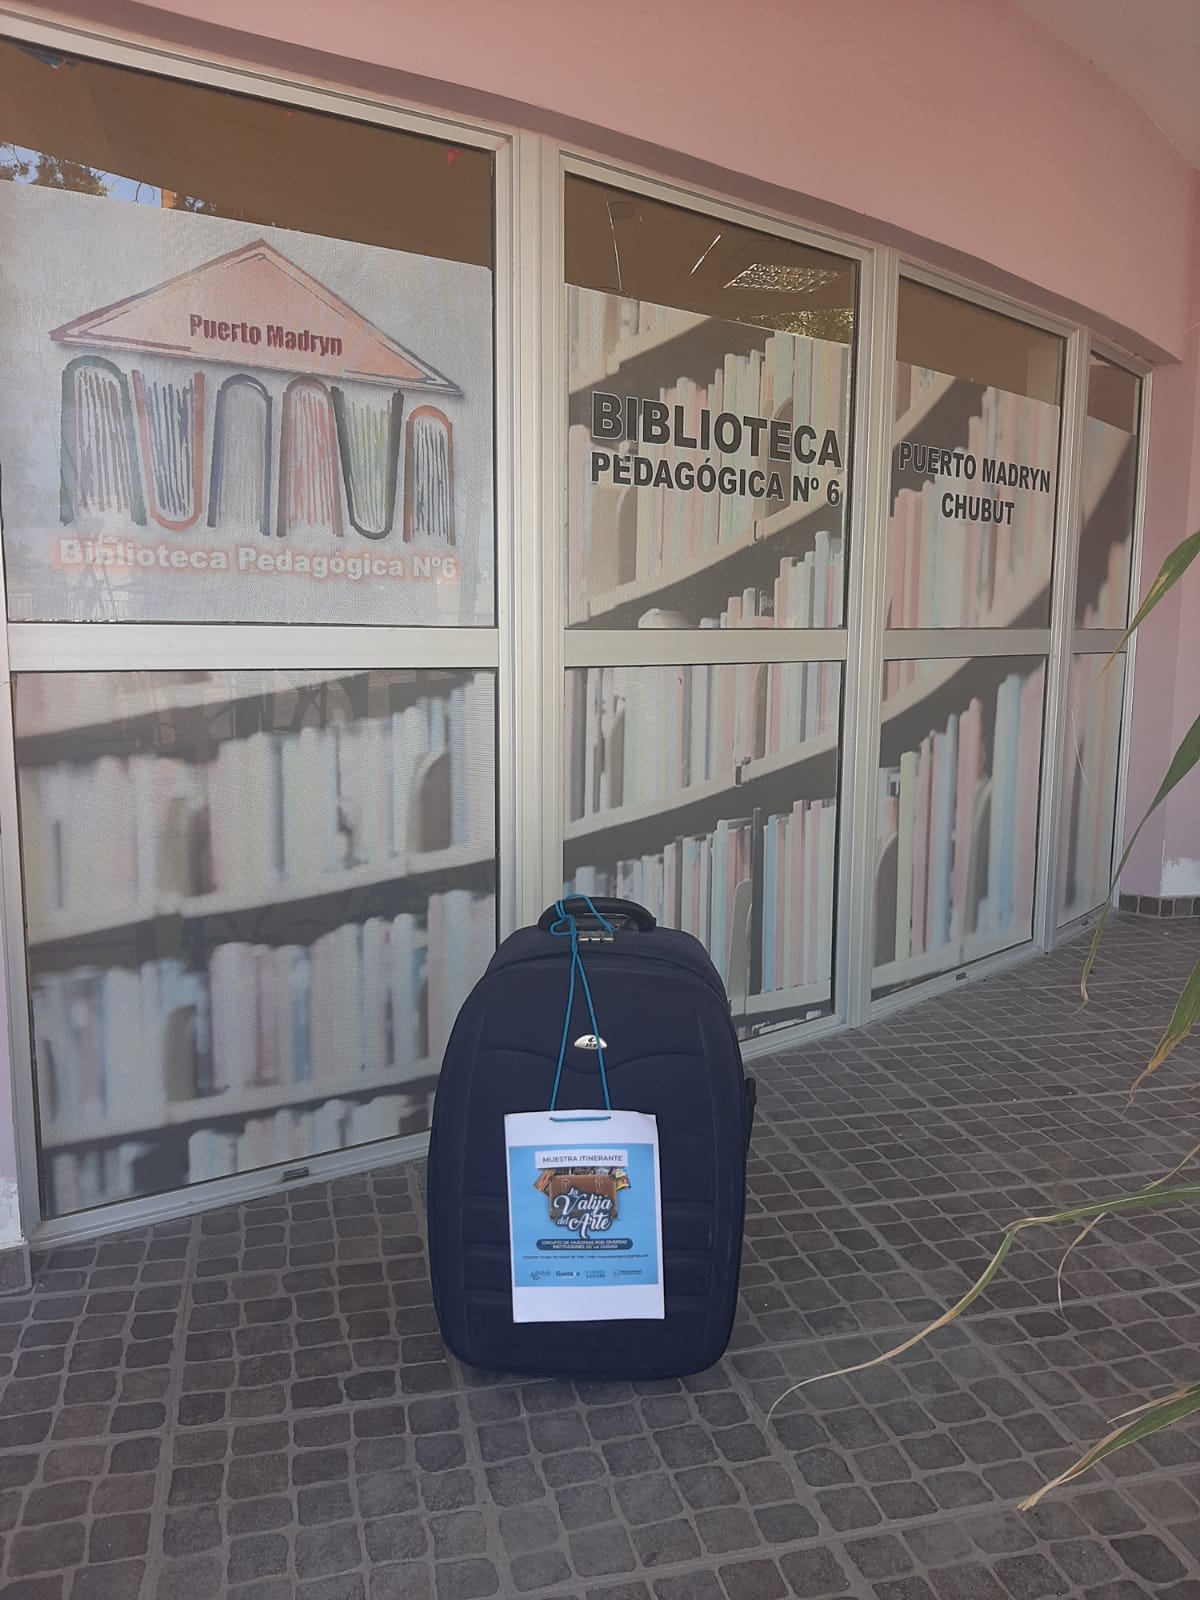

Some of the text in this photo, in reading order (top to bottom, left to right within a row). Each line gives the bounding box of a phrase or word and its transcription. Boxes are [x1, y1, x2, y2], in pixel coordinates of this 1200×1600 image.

[189, 313, 343, 356] Puerto Madryn
[591, 391, 842, 468] BIBLIOTECA
[591, 451, 785, 500] PEDAGÓGICA
[826, 479, 841, 506] 6
[899, 441, 1051, 493] PUERTO MADRYN
[941, 492, 1015, 525] CHUBUT
[58, 538, 228, 571] Biblioteca
[237, 547, 403, 579] Pedagógica
[542, 1154, 623, 1163] MUESTRA ITINERANTE
[553, 1193, 613, 1216] Valija
[557, 1212, 611, 1239] del Arte
